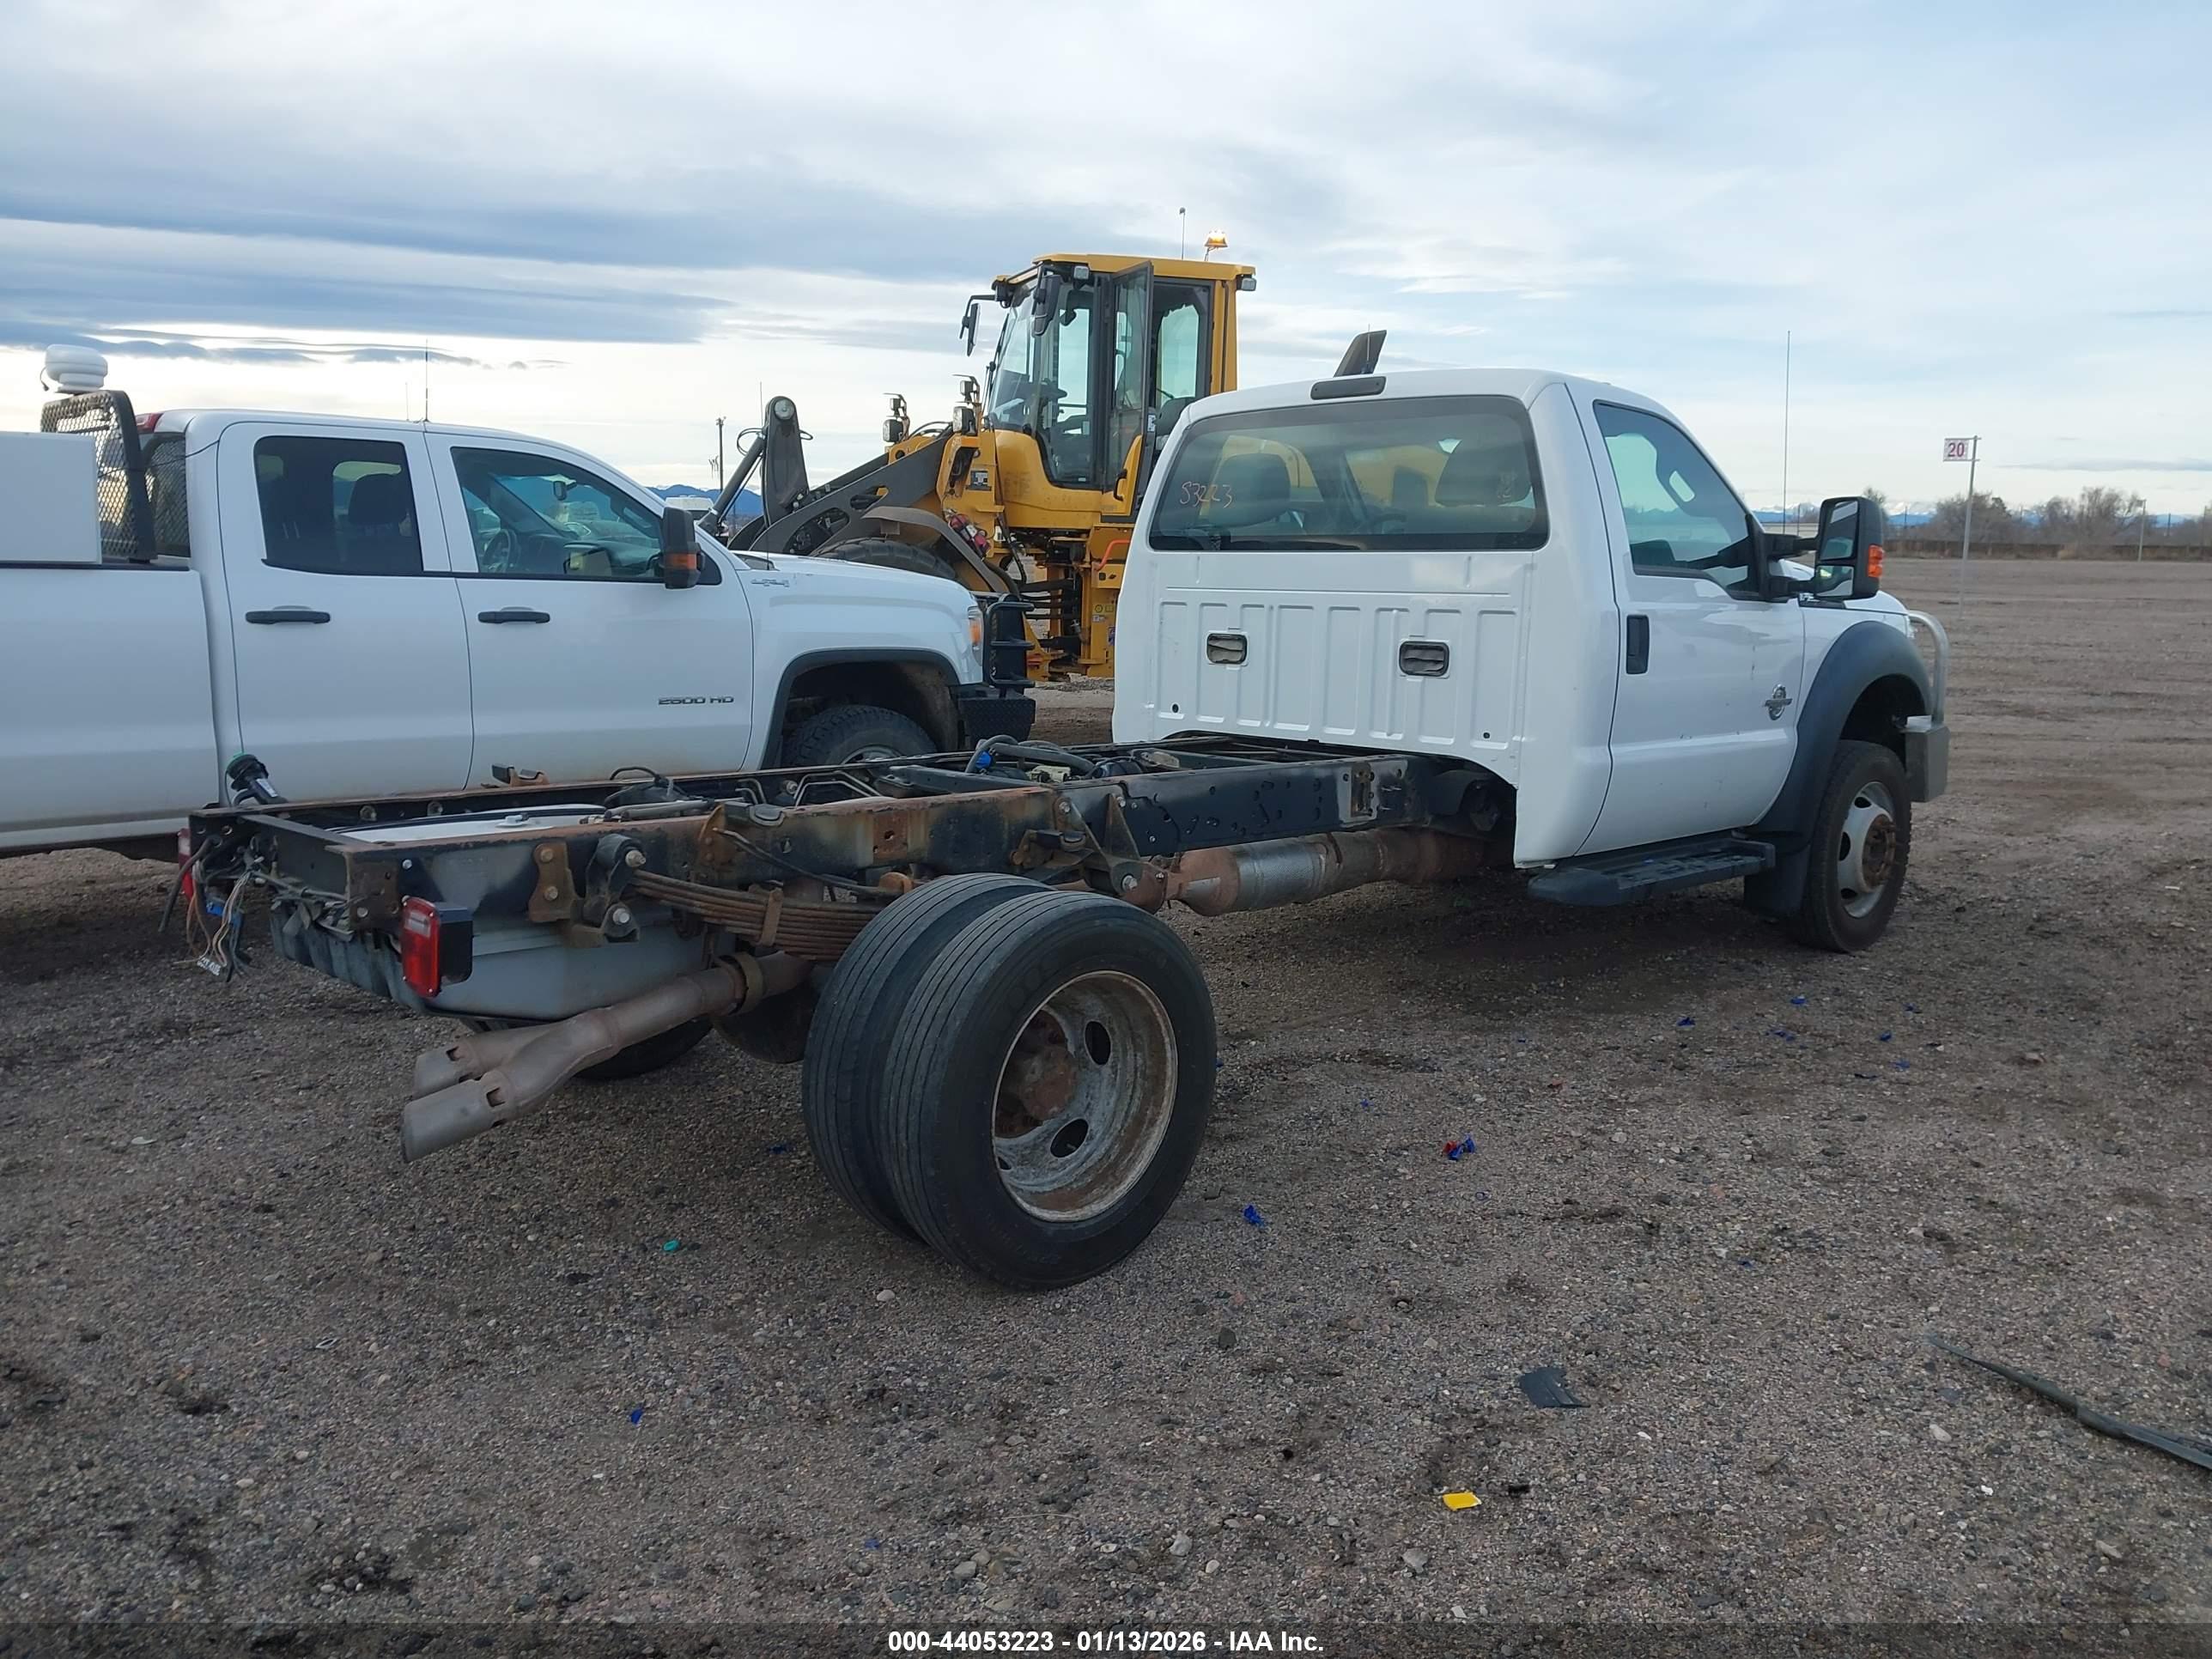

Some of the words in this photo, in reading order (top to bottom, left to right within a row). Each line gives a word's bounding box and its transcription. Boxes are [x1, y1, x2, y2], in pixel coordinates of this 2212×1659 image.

[1948, 442, 1965, 457] 20
[659, 696, 706, 705] 2500
[710, 696, 734, 704] HD
